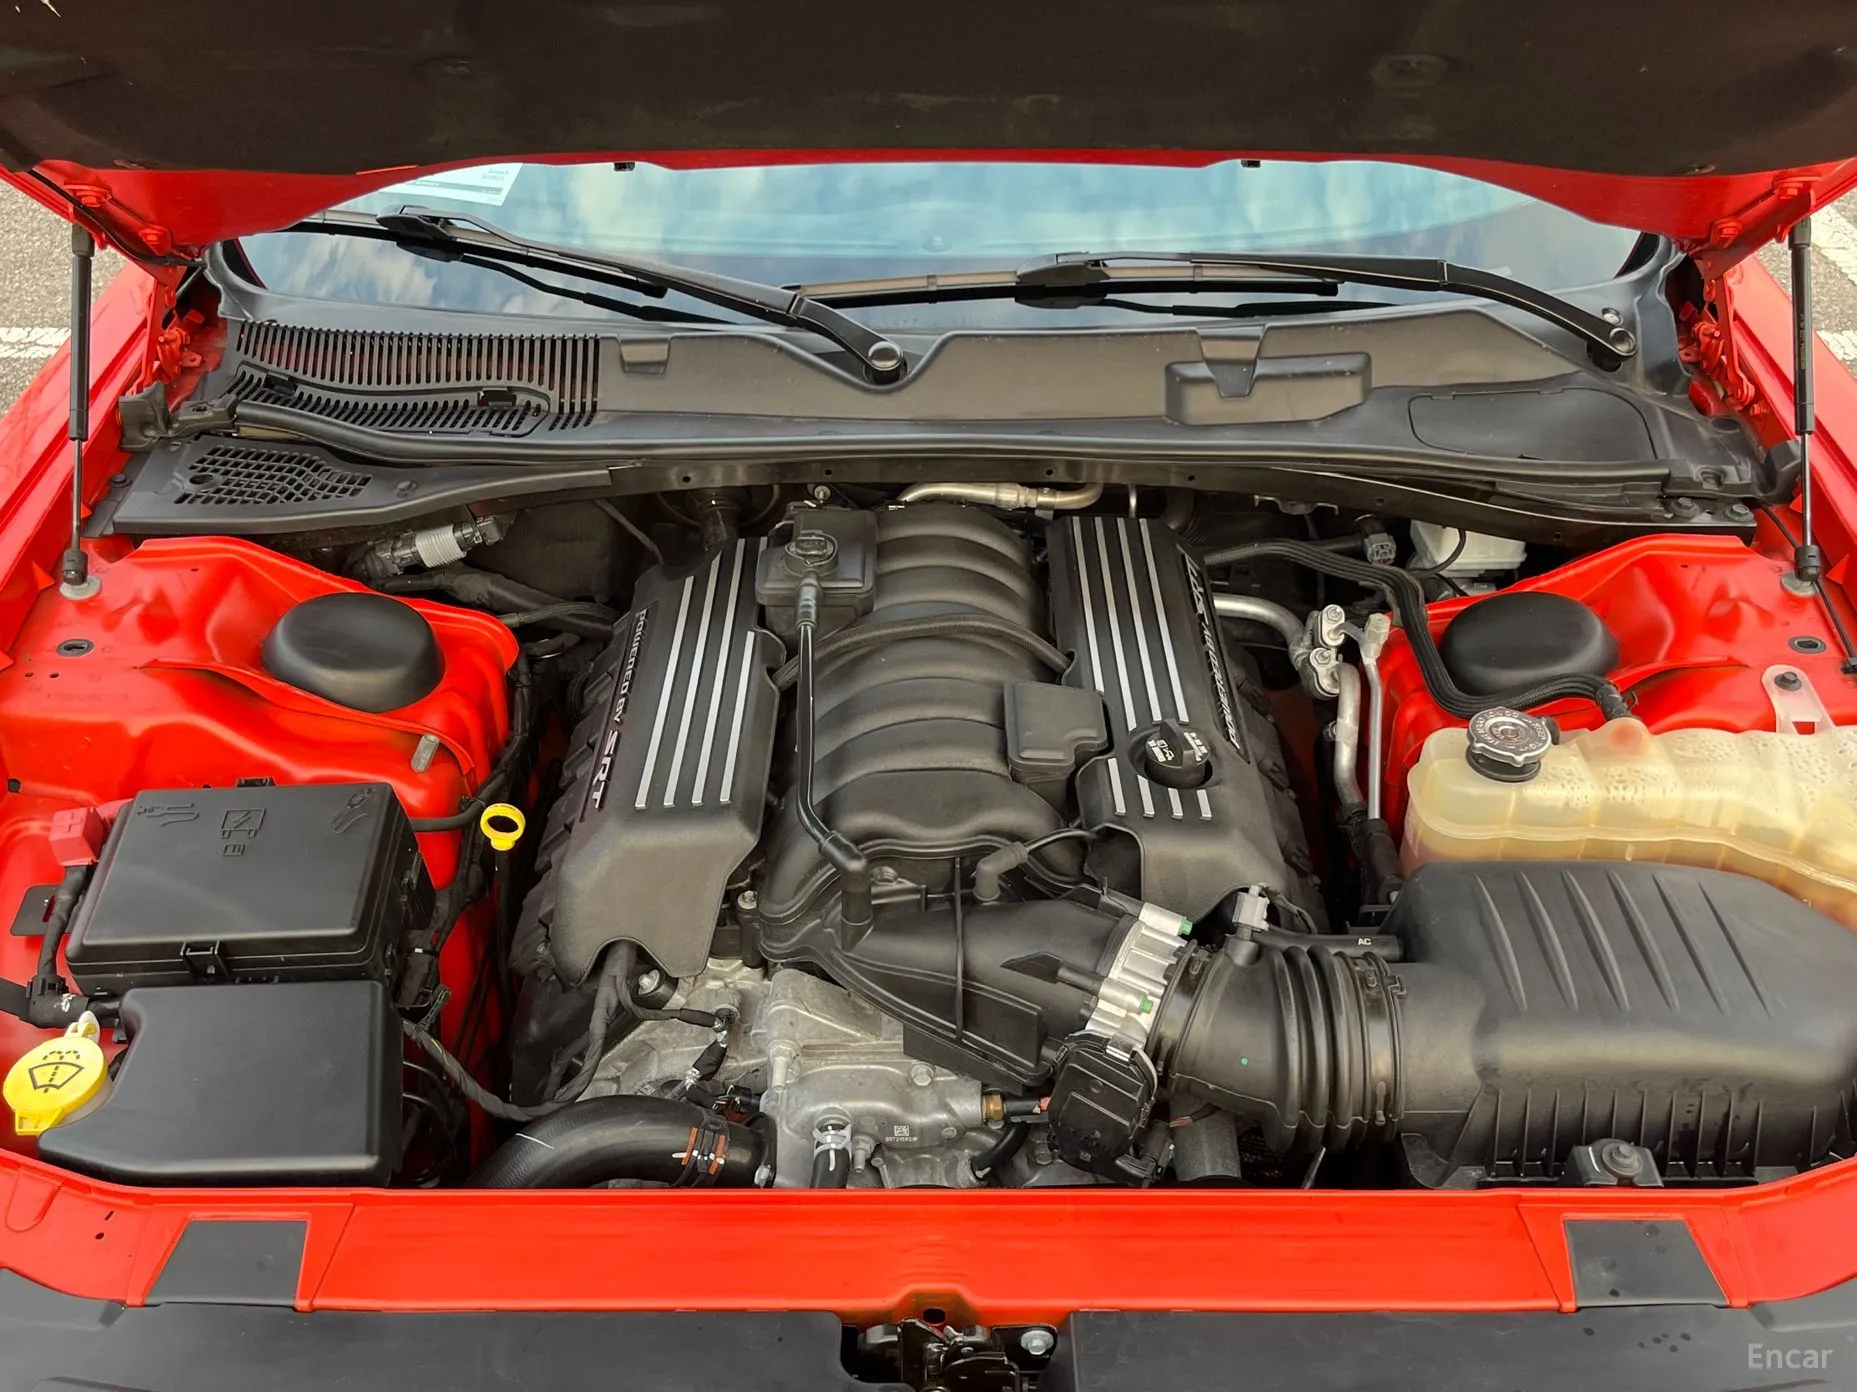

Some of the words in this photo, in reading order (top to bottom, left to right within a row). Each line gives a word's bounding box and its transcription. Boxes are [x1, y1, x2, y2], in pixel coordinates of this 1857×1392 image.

[1185, 552, 1209, 625] SRT
[620, 609, 647, 695] POWERED
[1208, 649, 1241, 750] POWERED
[592, 730, 618, 809] SRT
[1357, 937, 1372, 946] AC
